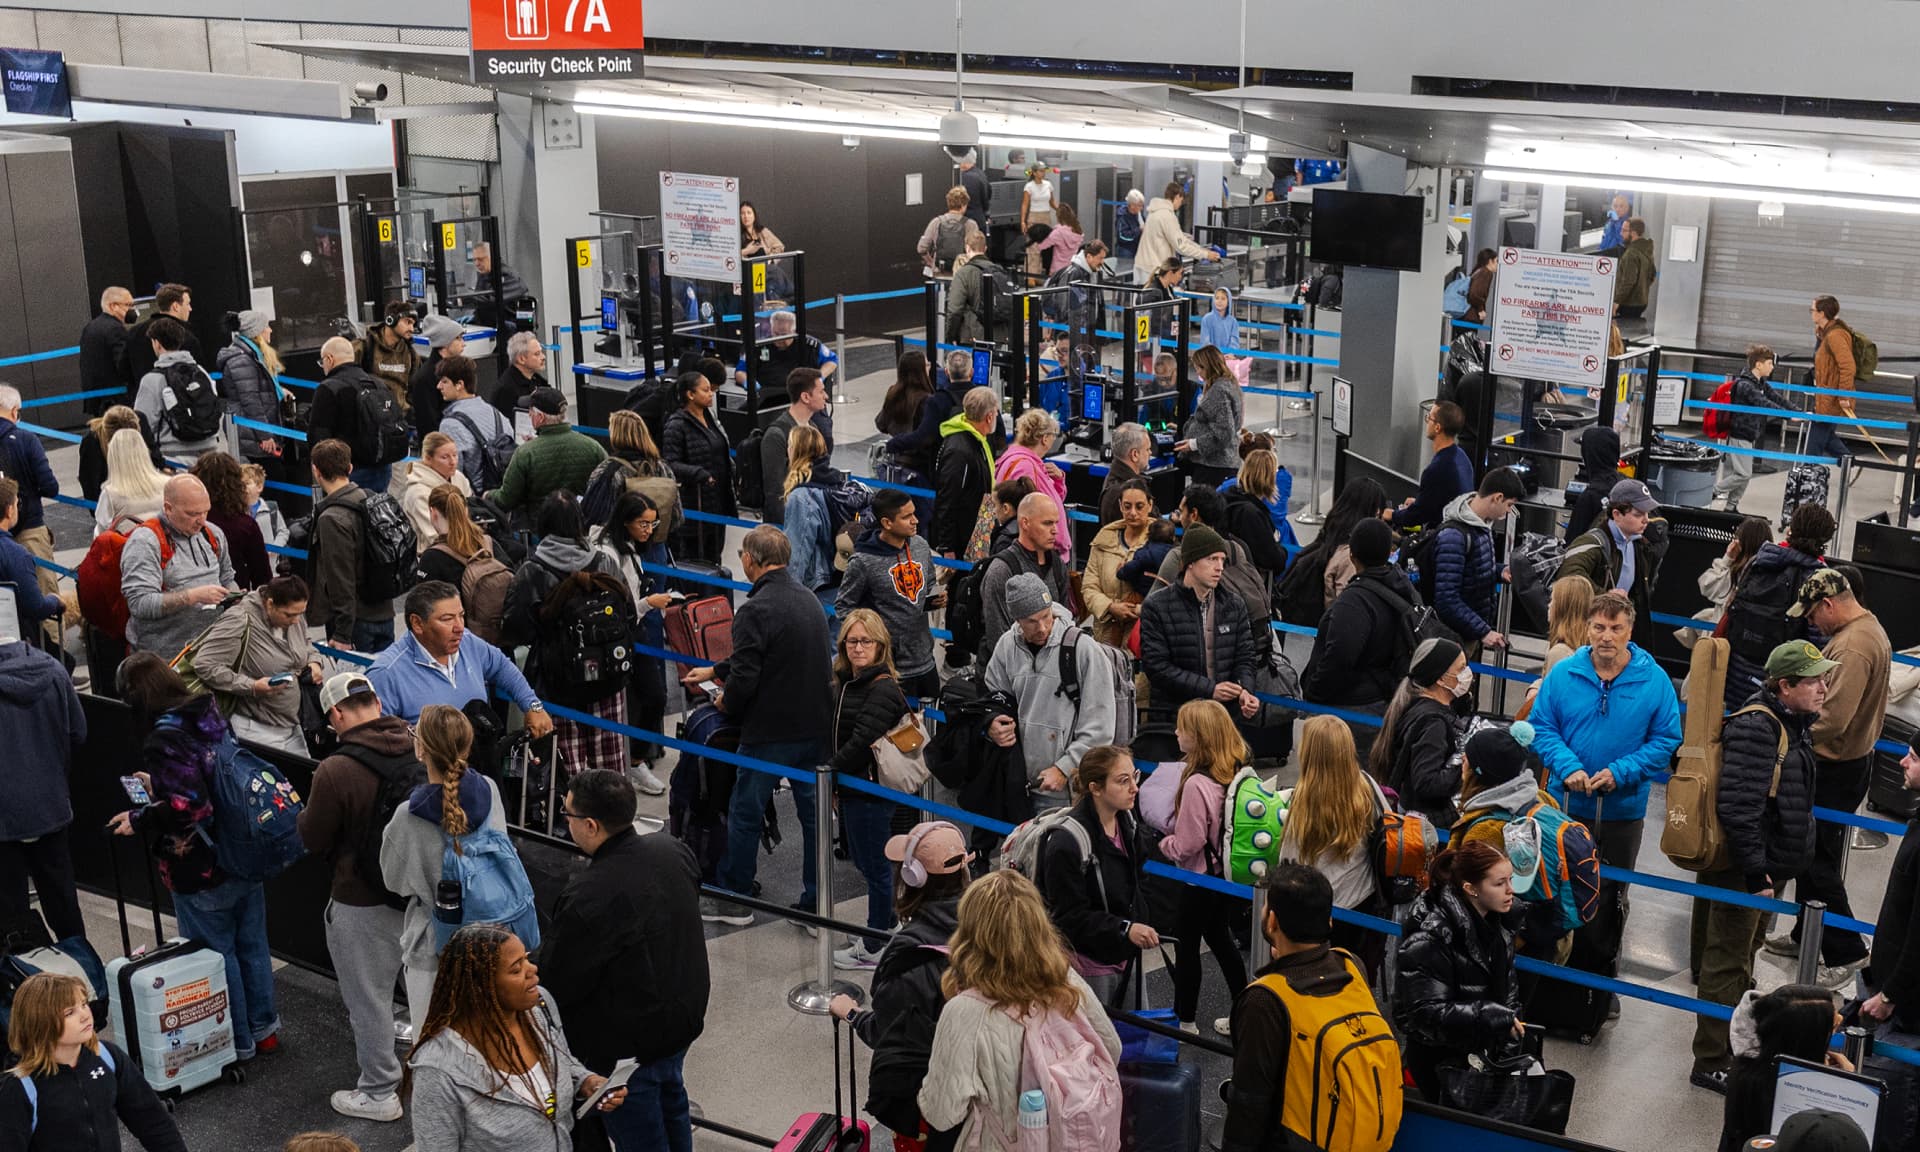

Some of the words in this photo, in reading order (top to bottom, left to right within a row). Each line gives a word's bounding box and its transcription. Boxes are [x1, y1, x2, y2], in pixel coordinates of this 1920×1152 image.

[564, 0, 612, 32] 7A
[488, 57, 546, 77] Security
[551, 57, 594, 73] Check
[598, 57, 632, 72] Point
[8, 70, 40, 82] FLAGSHIP
[40, 72, 58, 84] FIRST
[382, 222, 389, 238] 6
[445, 232, 454, 248] 6
[580, 248, 588, 266] 5
[755, 272, 763, 289] 4
[1513, 298, 1549, 308] FIREARMS
[1568, 304, 1604, 314] ALLOWED
[1521, 309, 1539, 317] PAST
[1560, 314, 1580, 322] POINT
[1139, 320, 1147, 339] 2
[1784, 1081, 1805, 1090] Identity
[1806, 1086, 1837, 1098] Verification
[1839, 1095, 1869, 1108] Technology
